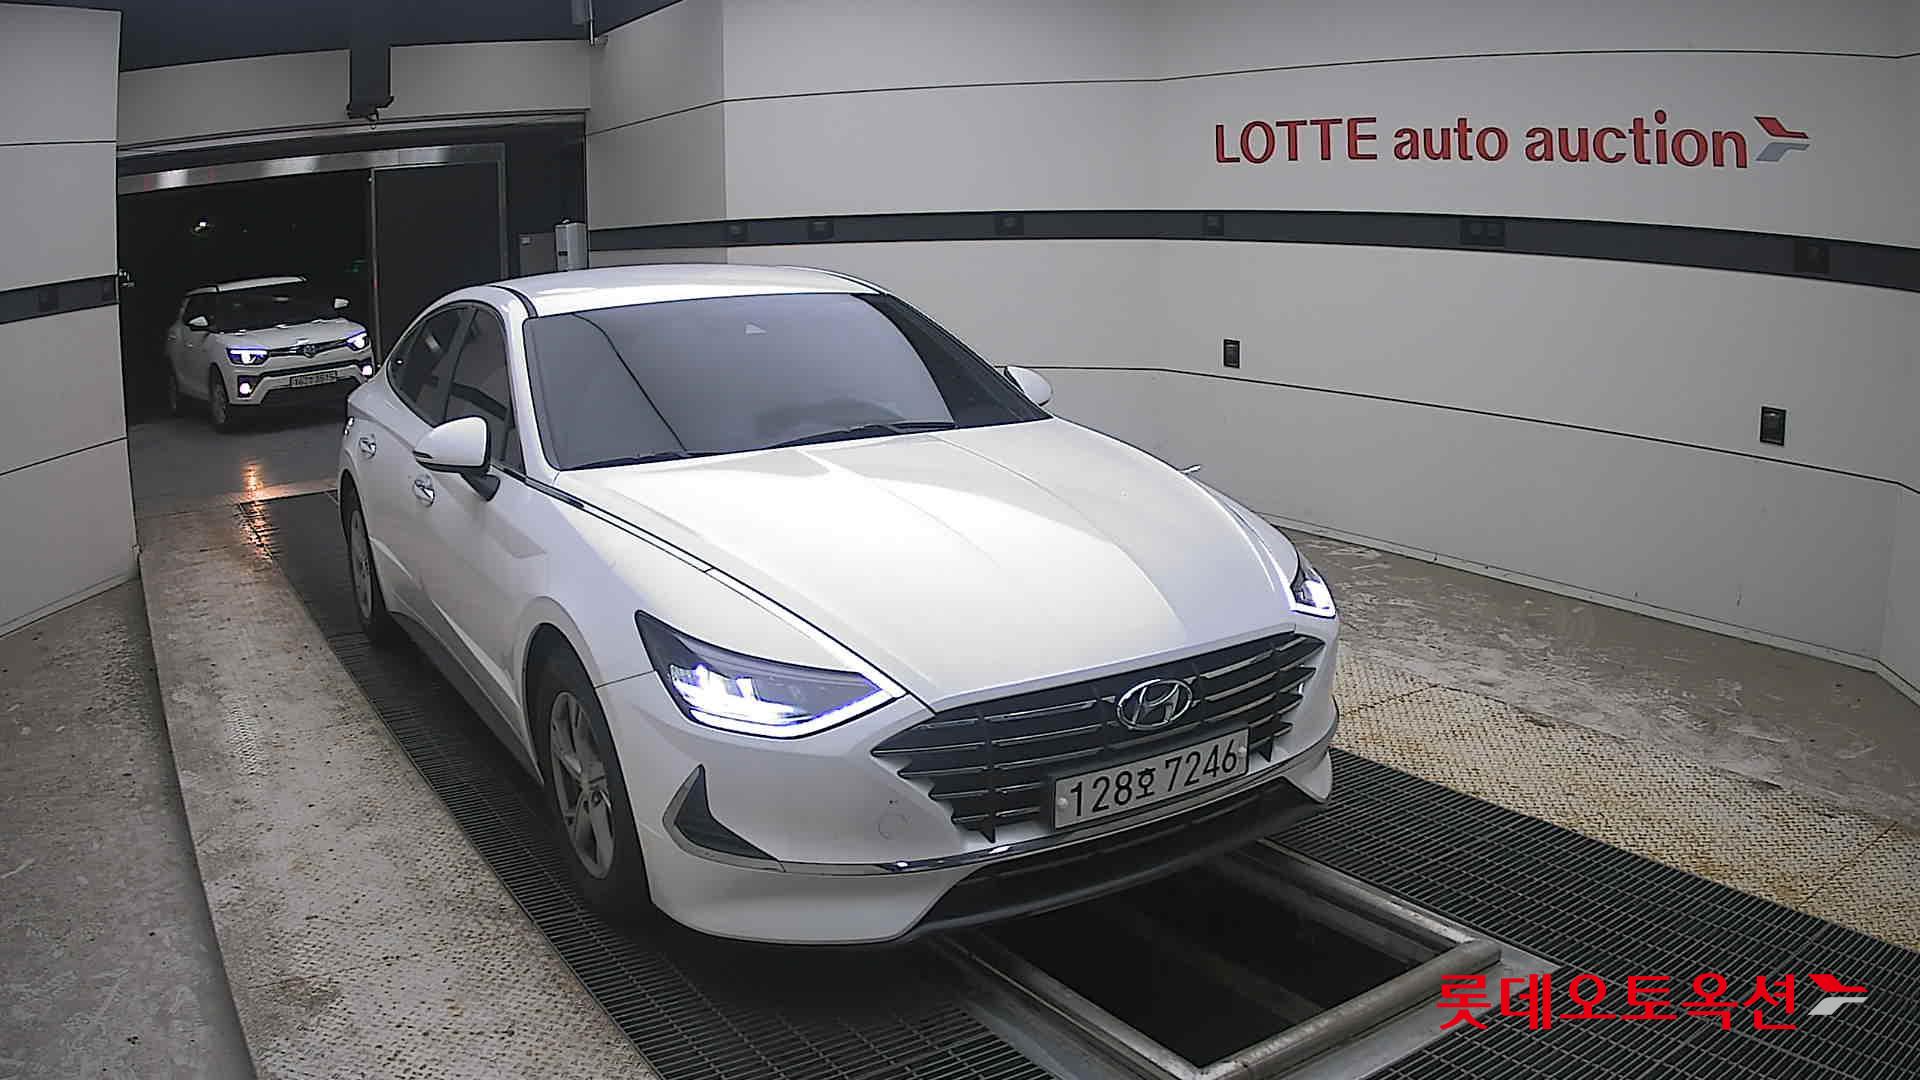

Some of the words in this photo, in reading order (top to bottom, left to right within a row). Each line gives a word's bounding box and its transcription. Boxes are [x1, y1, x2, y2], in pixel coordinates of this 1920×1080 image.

[1215, 117, 1377, 164] LOTTE
[1394, 118, 1509, 161] auto
[1525, 110, 1749, 168] auction
[1070, 767, 1156, 817] 128호
[1165, 738, 1238, 792] 7246
